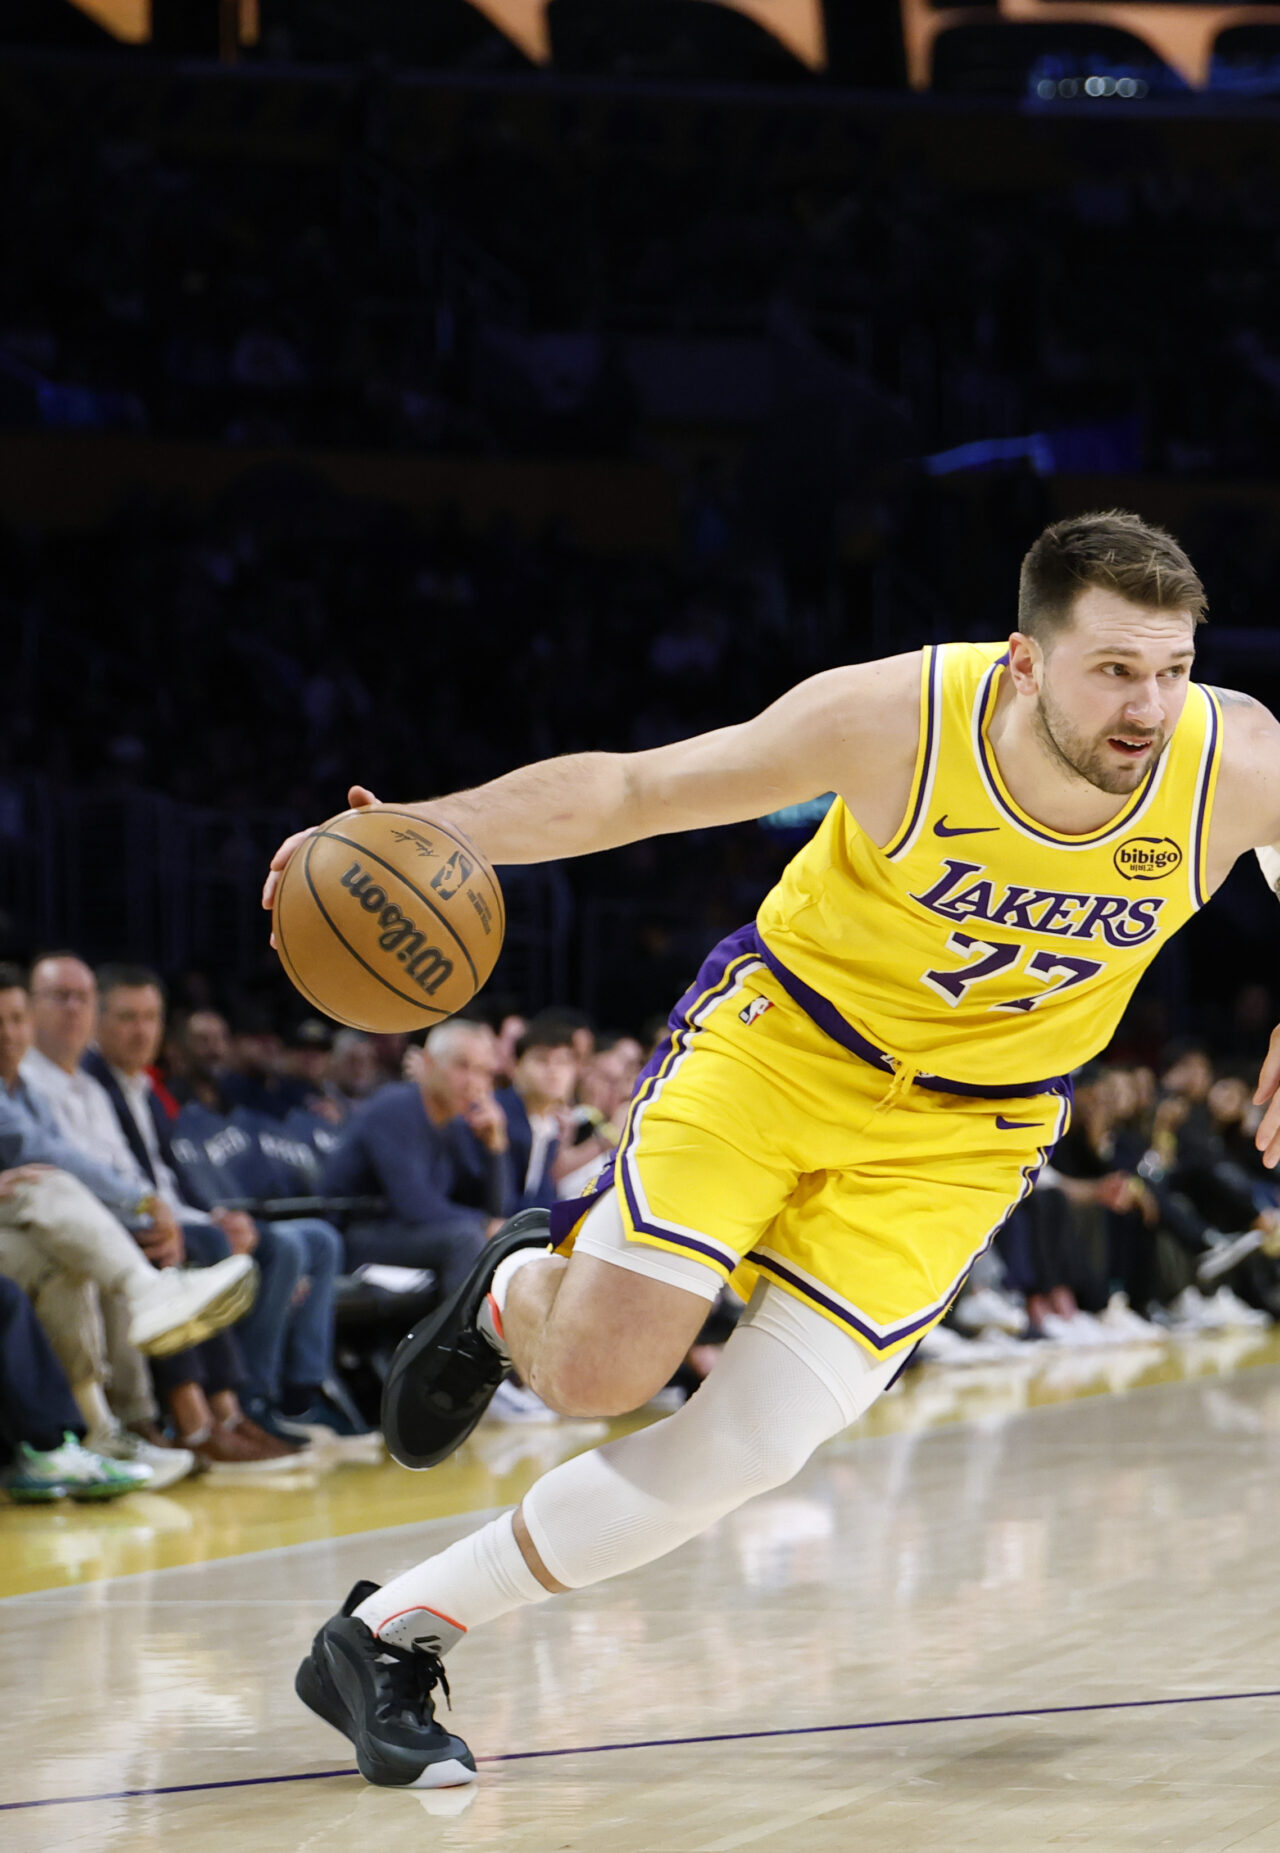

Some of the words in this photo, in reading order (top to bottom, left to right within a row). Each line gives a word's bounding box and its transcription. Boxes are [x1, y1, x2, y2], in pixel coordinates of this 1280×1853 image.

[1121, 849, 1178, 868] bibigo
[341, 861, 454, 996] Wilson
[908, 858, 1168, 949] LAKERS
[919, 931, 1107, 1014] 77
